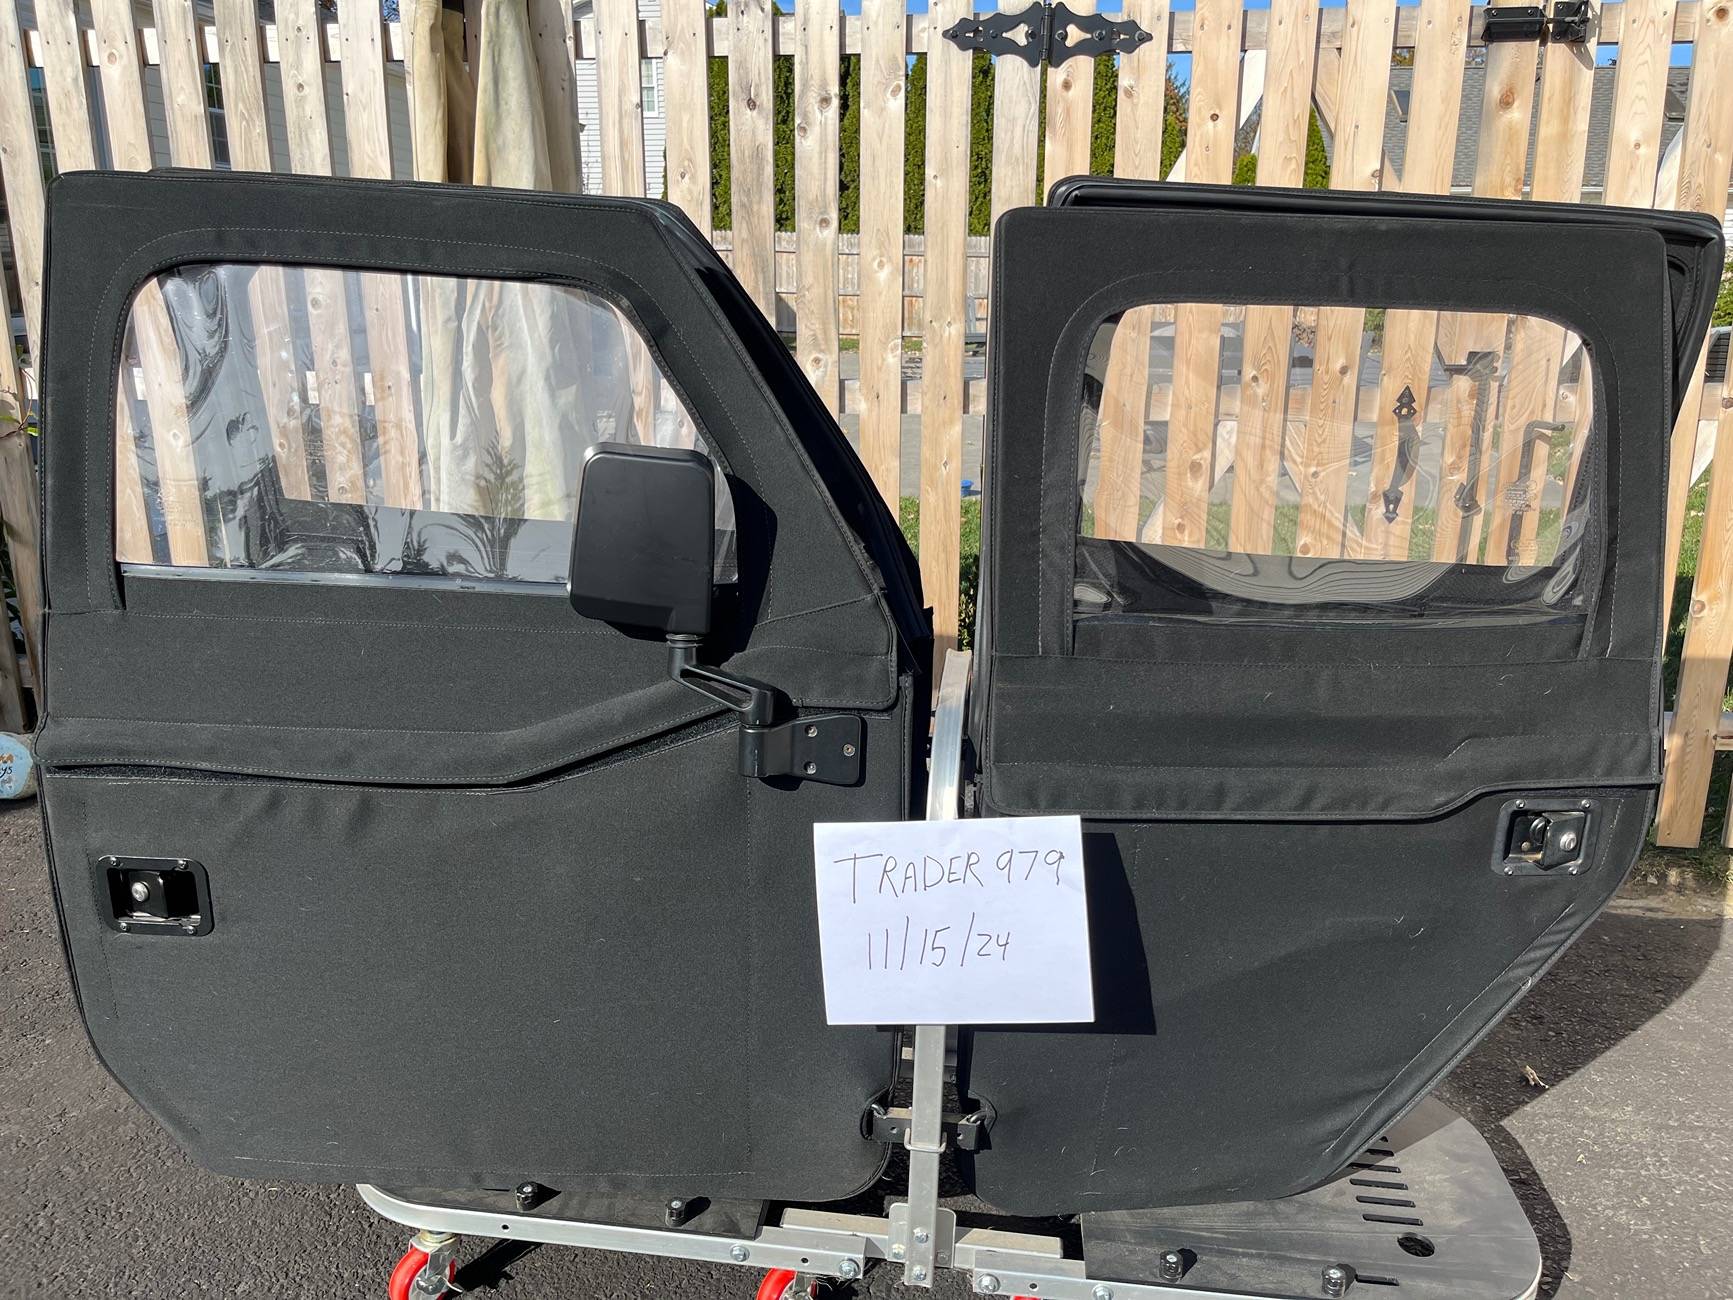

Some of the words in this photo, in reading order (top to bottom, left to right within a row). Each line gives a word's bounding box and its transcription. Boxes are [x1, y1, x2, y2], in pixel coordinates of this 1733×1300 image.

[833, 853, 984, 904] TRADER
[996, 849, 1065, 885] 979
[868, 912, 1010, 971] 11/15/24
